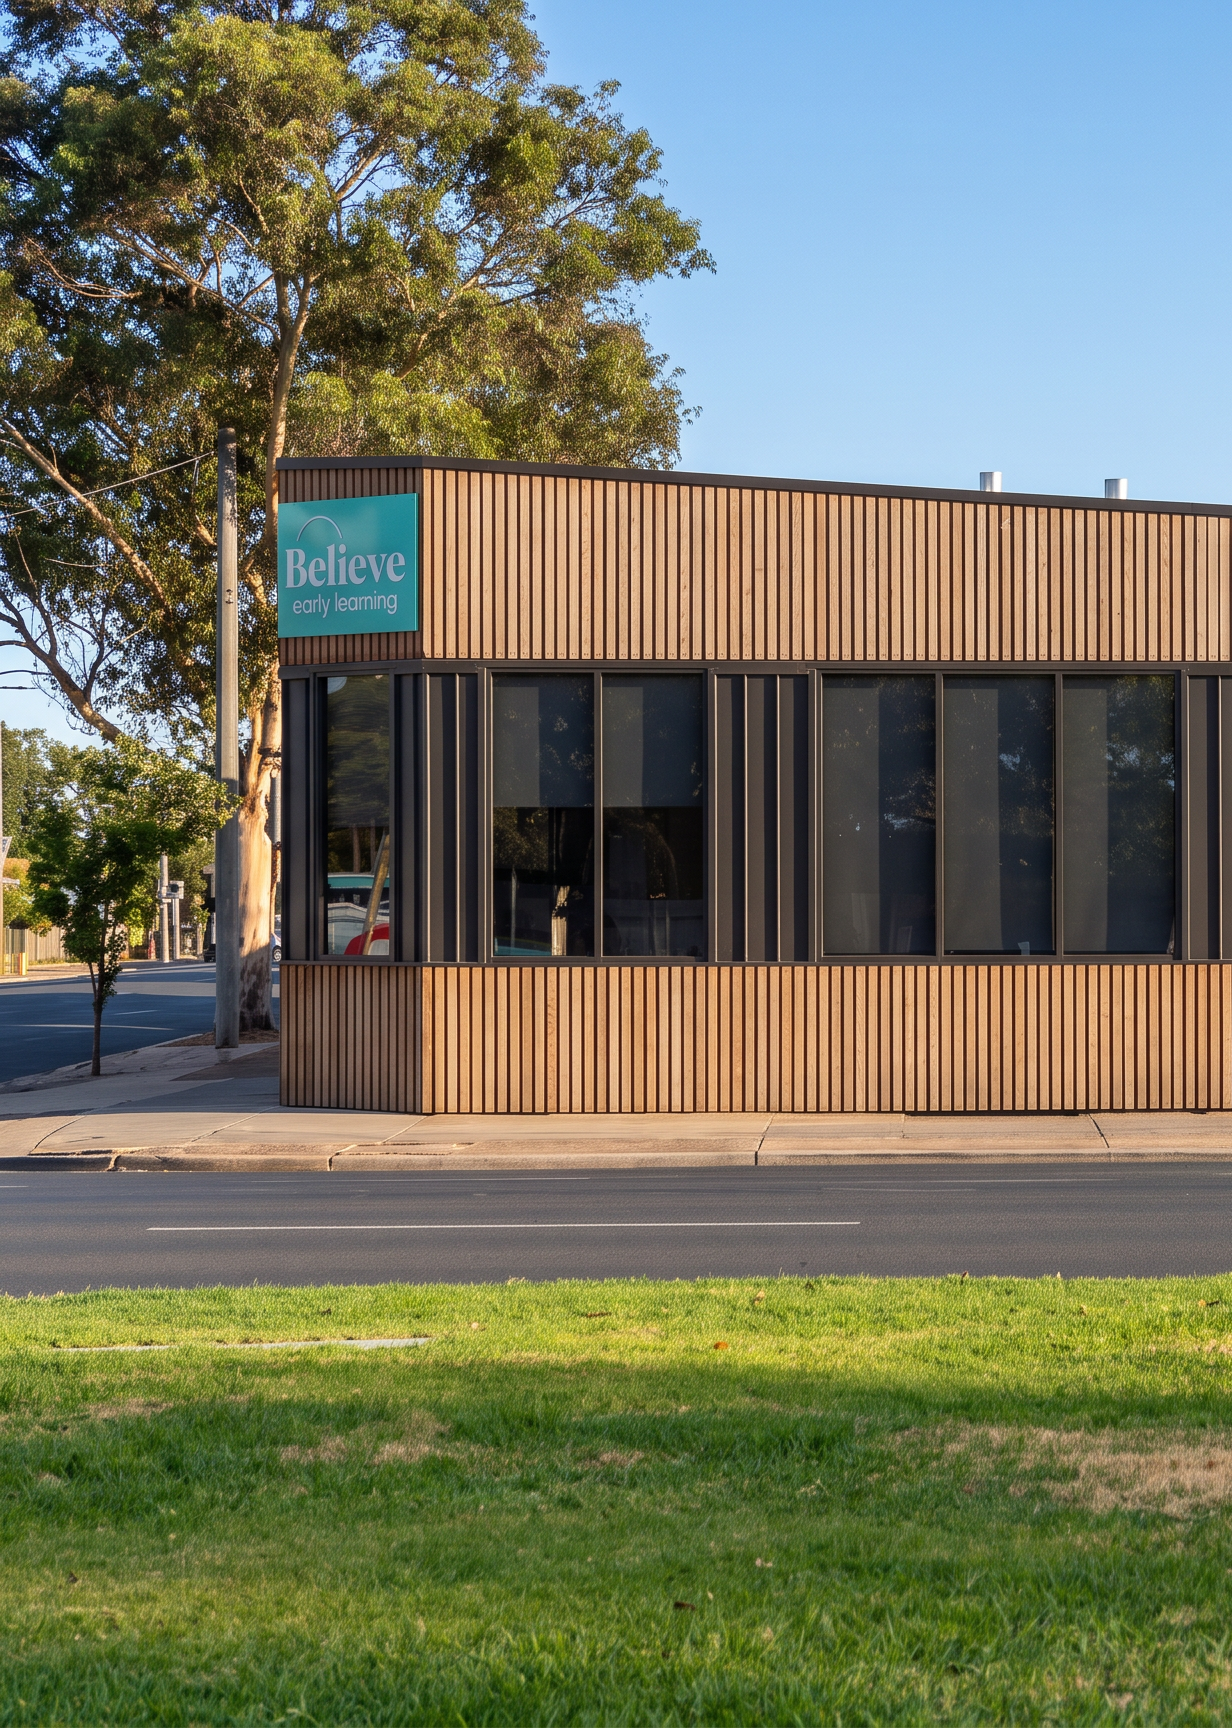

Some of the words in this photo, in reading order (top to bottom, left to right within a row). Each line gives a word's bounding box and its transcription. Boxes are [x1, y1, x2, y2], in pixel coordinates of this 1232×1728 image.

[285, 543, 406, 589] Believe
[292, 593, 331, 619] early
[334, 590, 398, 615] learning
